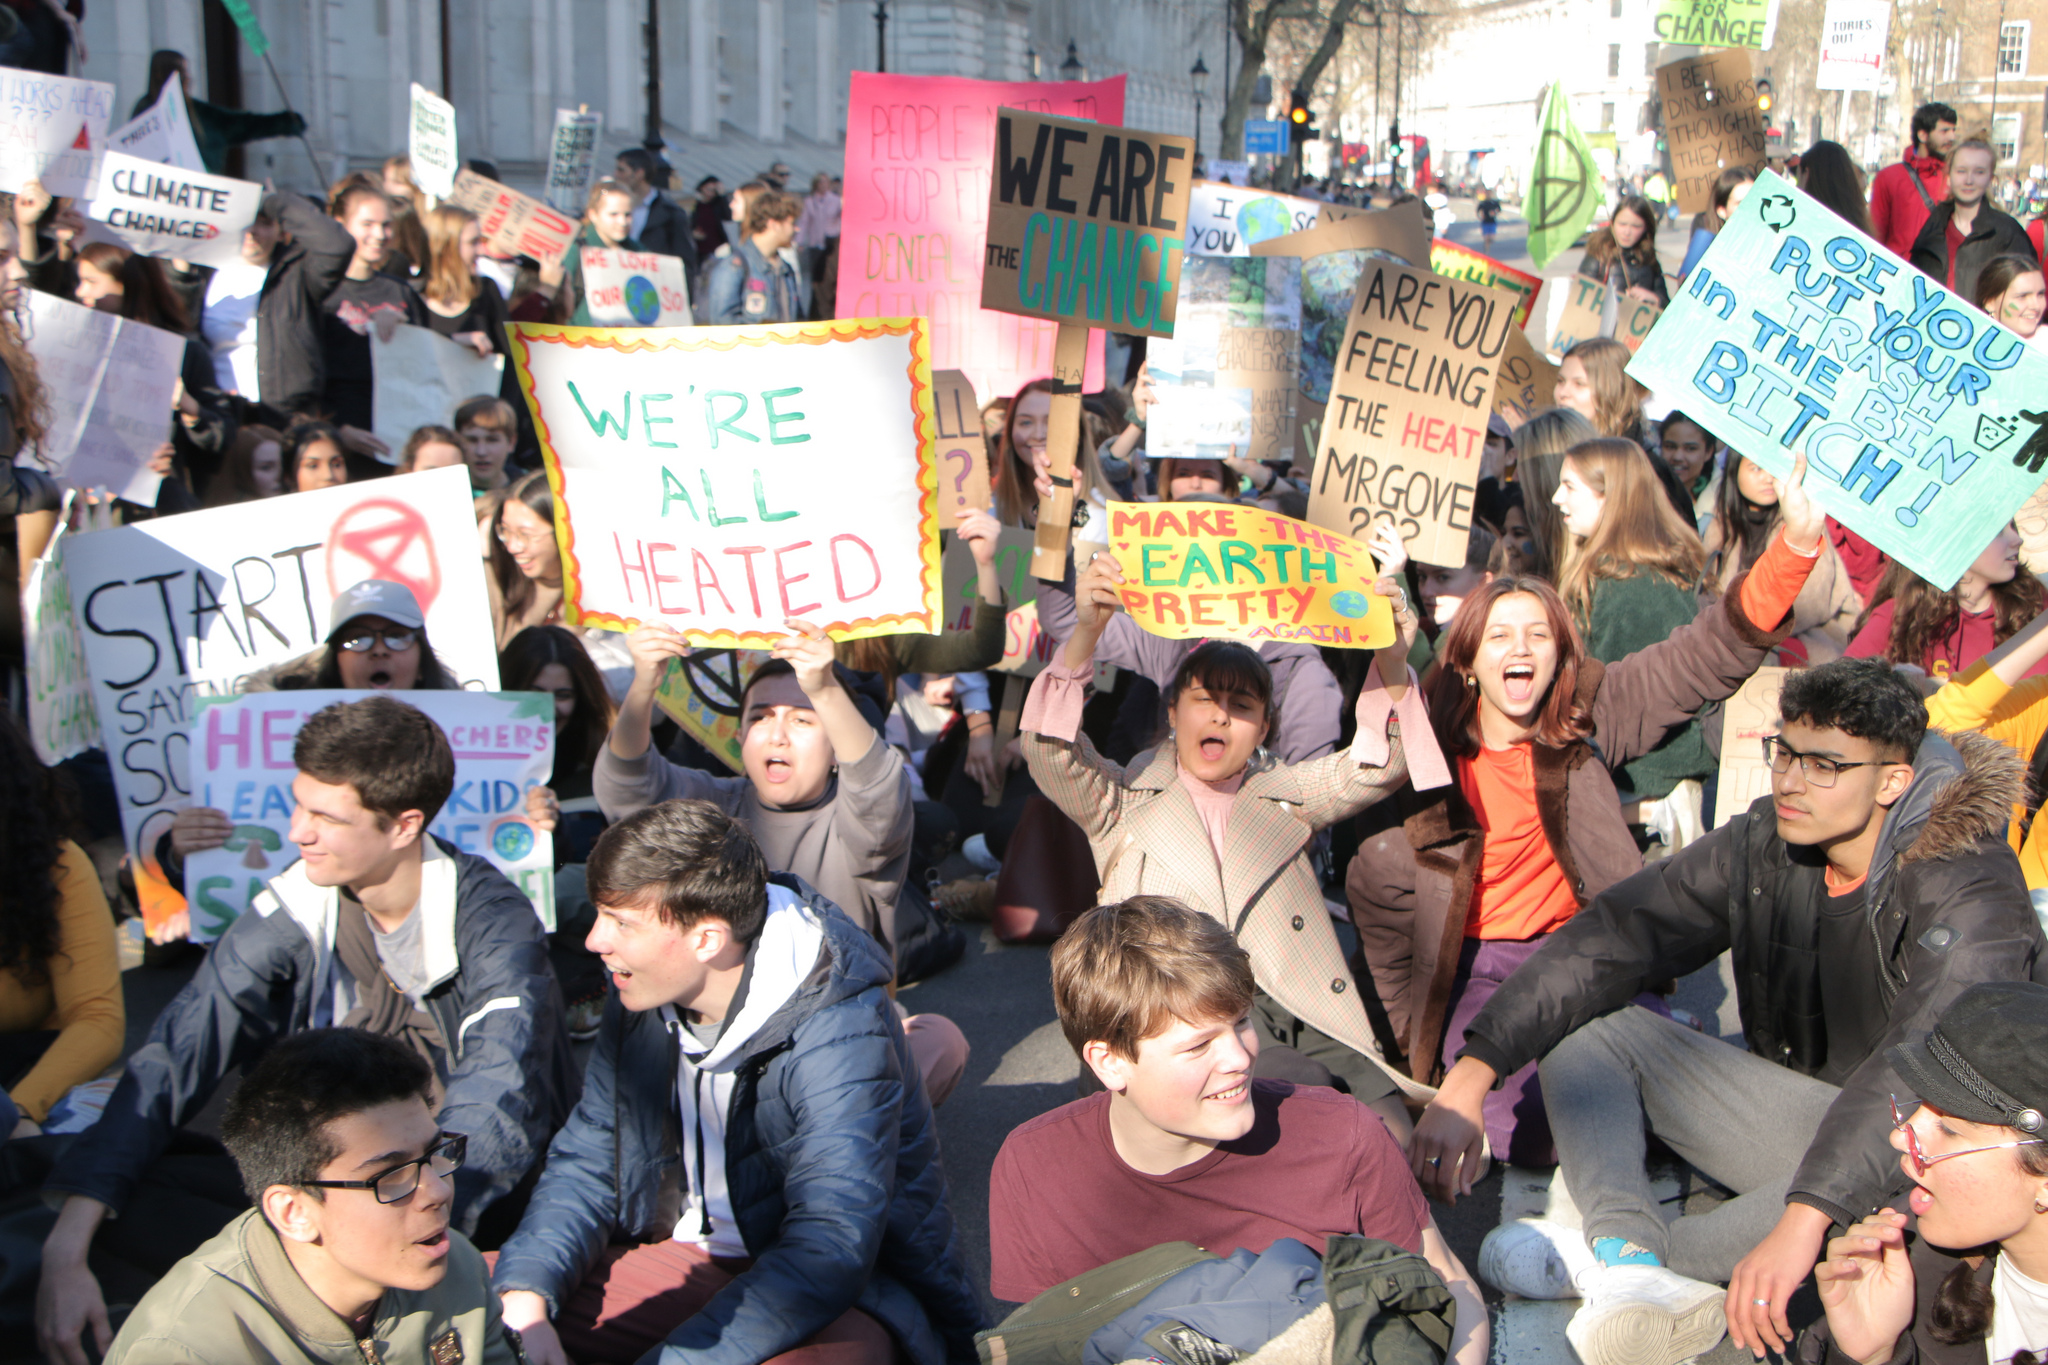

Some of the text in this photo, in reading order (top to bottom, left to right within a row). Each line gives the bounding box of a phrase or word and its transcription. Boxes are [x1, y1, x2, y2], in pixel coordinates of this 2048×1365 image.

[1653, 13, 1767, 47] CHANGE
[1691, 2, 1727, 19] FOR
[1833, 19, 1872, 32] TORIES
[1831, 33, 1853, 44] OUT
[1680, 60, 1719, 90] BET
[1667, 79, 1757, 120] DINOSAURS
[871, 104, 972, 163] PEOPLE
[1669, 105, 1760, 144] THOUGHT
[998, 116, 1187, 231] WE ARE
[1675, 132, 1766, 169] THEY HAD
[112, 169, 231, 213] CLIMATE
[871, 167, 941, 225] STOP
[1213, 198, 1234, 220] I
[107, 207, 221, 240] CHANGED
[1191, 226, 1237, 254] YOU
[617, 250, 659, 273] LOVE
[866, 233, 964, 283] DENIAL
[986, 244, 1019, 271] THE
[1018, 212, 1185, 334] CHANGE
[591, 286, 683, 312] OUR SO
[1361, 267, 1440, 331] ARE
[1443, 286, 1518, 359] YOU
[1770, 235, 1992, 406] PUT YOUR
[1824, 236, 2024, 370] OI YOU
[1216, 349, 1296, 373] CHALLENGE
[1344, 330, 1489, 409] FEELING
[1785, 291, 1955, 423] TRASH
[566, 380, 812, 449] WE'RE
[1252, 387, 1294, 413] WHAT
[1750, 310, 1844, 400] THE
[1851, 389, 1981, 485] BIN
[1252, 414, 1294, 435] NEXT
[1336, 394, 1482, 459] THE HEAT
[660, 465, 801, 528] ALL
[1112, 510, 1352, 559] MAKE THE
[613, 531, 883, 618] HEATED
[1140, 540, 1339, 588] EARTH
[84, 543, 323, 690] START
[1120, 585, 1317, 626] PRETTY
[1247, 623, 1352, 643] AGAIN
[206, 707, 311, 772] HE
